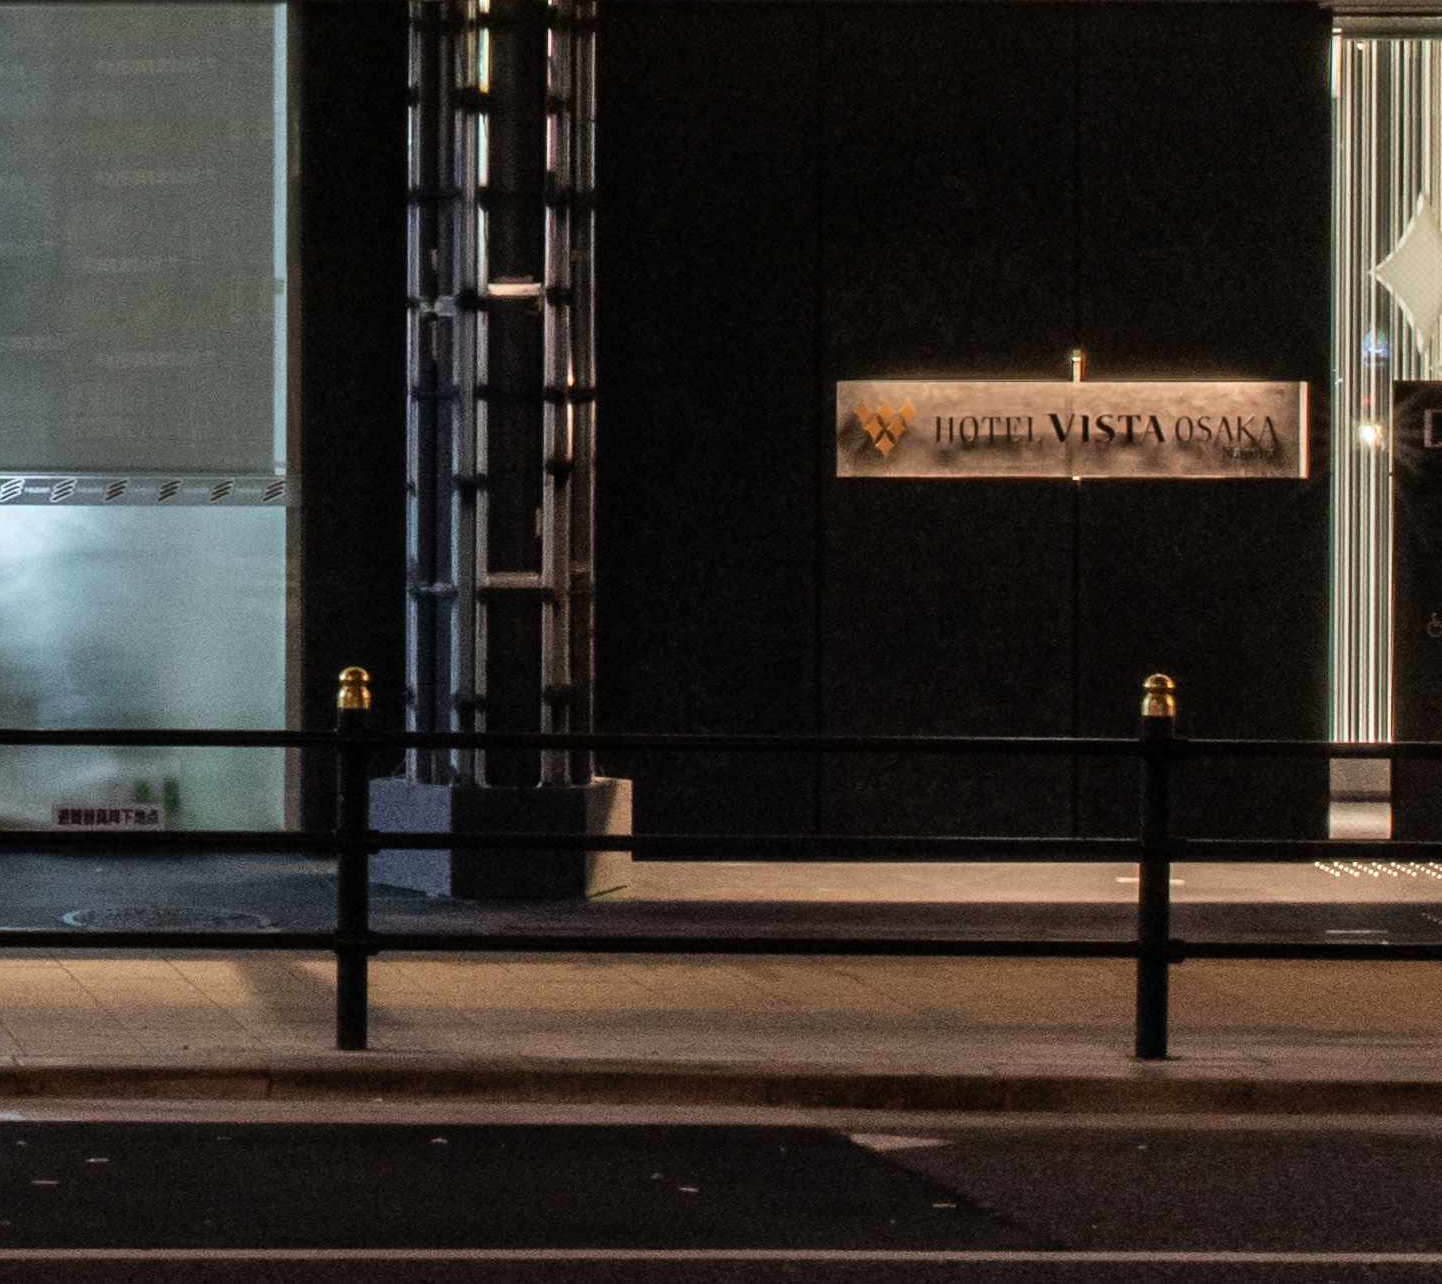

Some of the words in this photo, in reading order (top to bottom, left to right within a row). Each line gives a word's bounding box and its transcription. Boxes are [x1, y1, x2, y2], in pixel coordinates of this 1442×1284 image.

[934, 415, 1040, 444] HOTEL
[1047, 412, 1166, 444] VISTA
[1175, 415, 1280, 445] OSAKA
